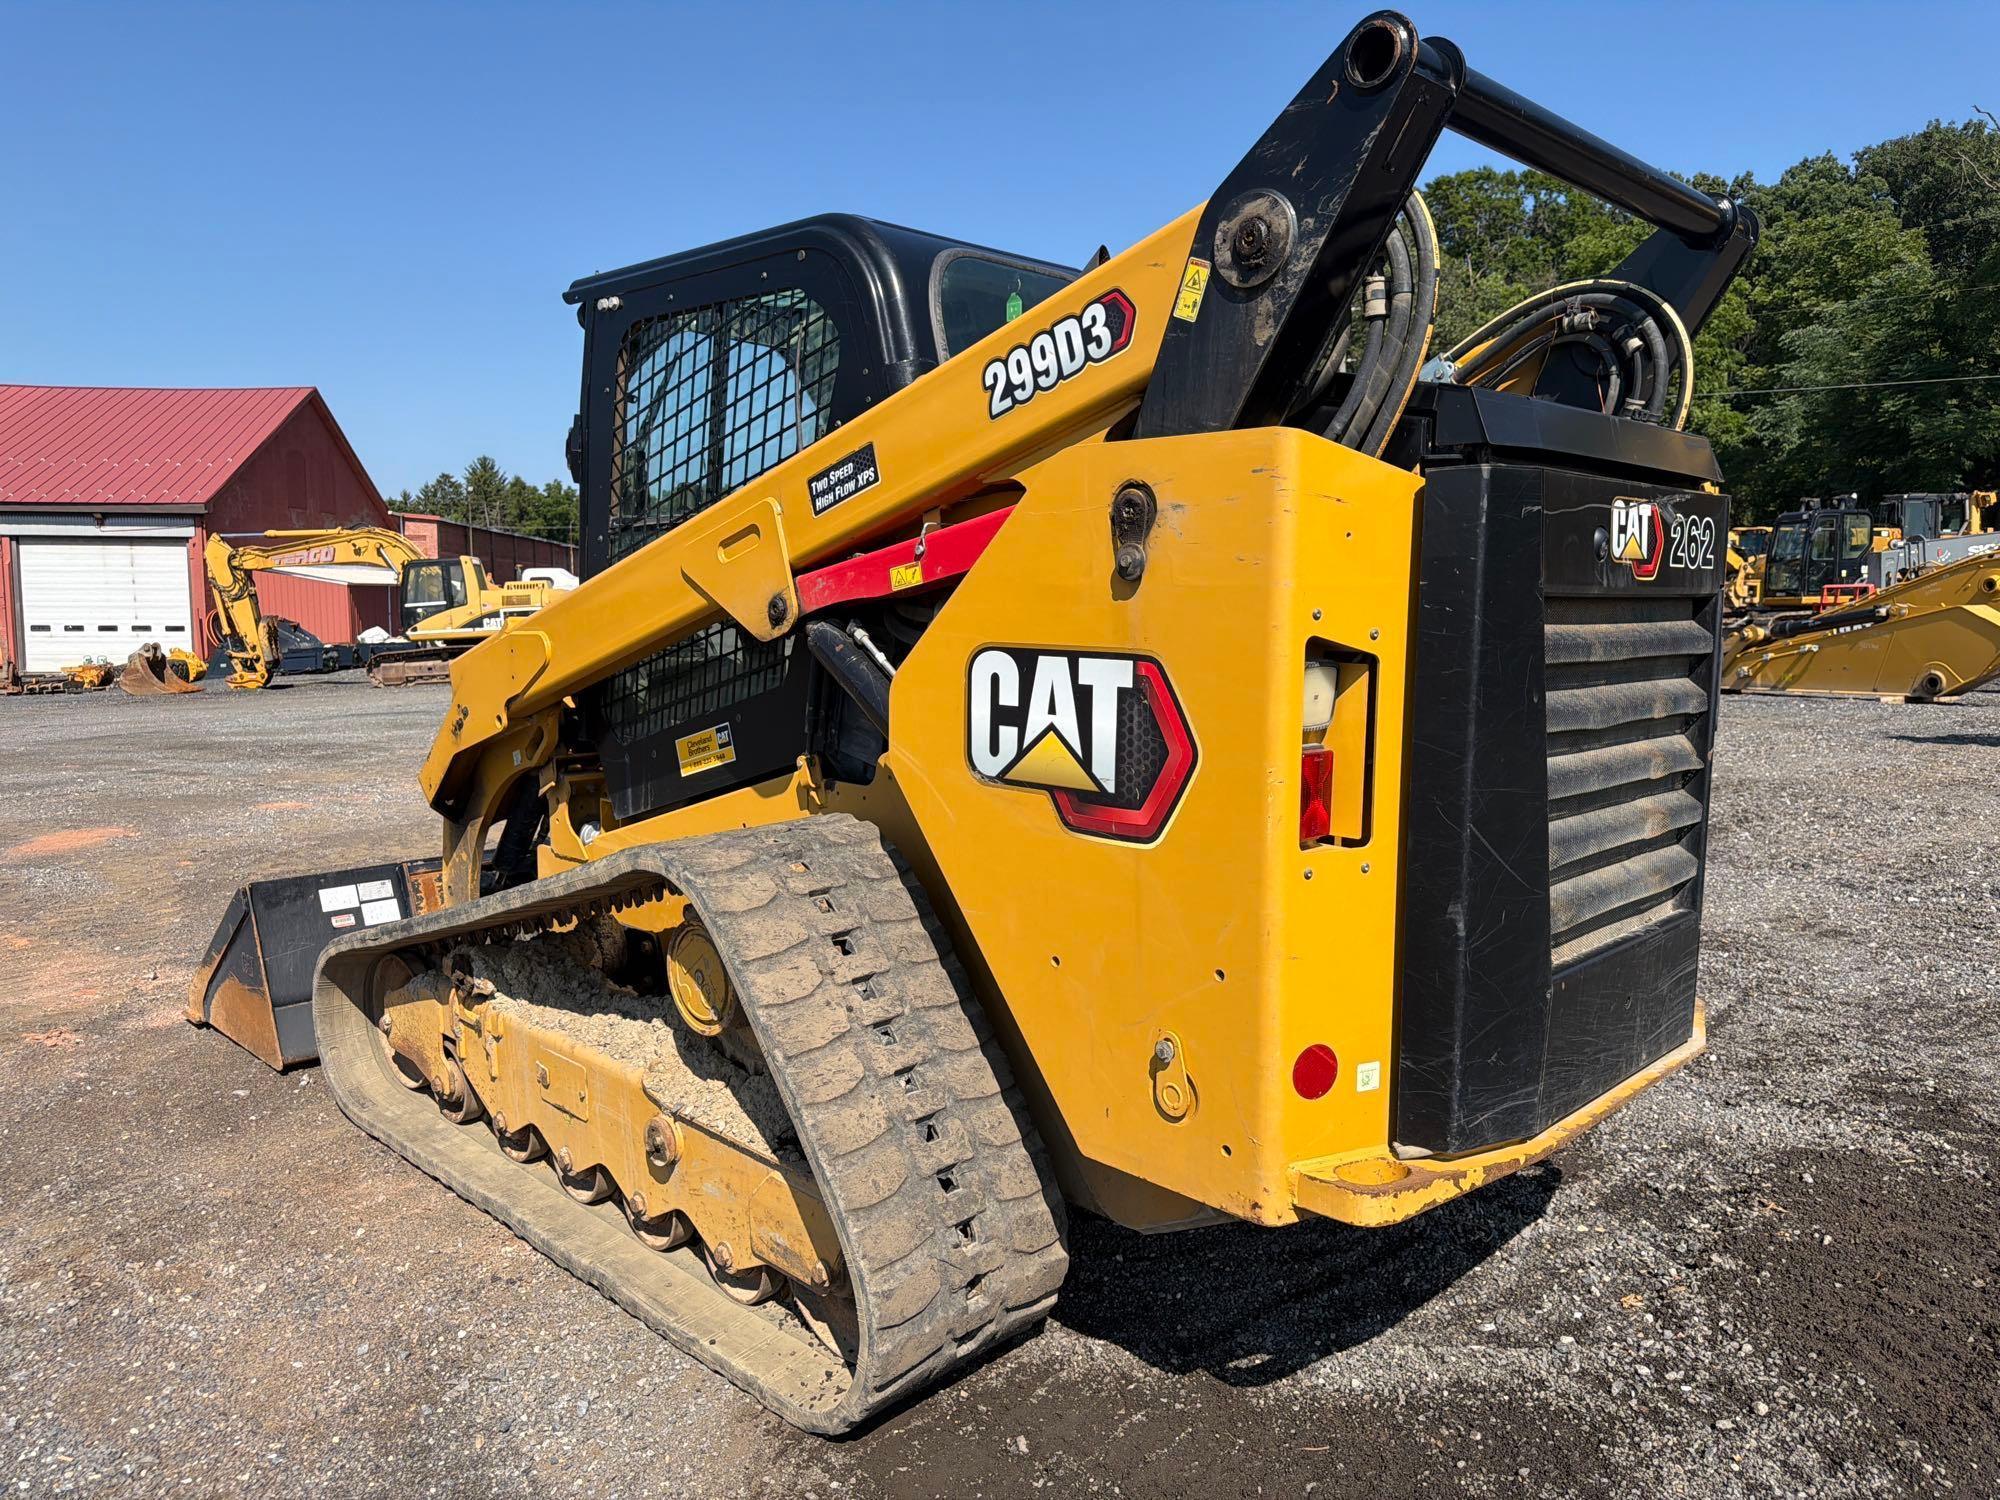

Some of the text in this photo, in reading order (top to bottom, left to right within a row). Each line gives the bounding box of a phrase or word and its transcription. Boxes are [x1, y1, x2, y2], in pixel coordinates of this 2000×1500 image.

[984, 303, 1112, 416] 299D3
[811, 462, 854, 496] TWO SPEED
[815, 467, 875, 512] HIGH FLOW XPS
[1612, 500, 1716, 569] CAT 262
[482, 616, 503, 631] CAT
[687, 734, 712, 748] Cleveland
[717, 730, 729, 744] CAT
[970, 649, 1135, 795] CAT
